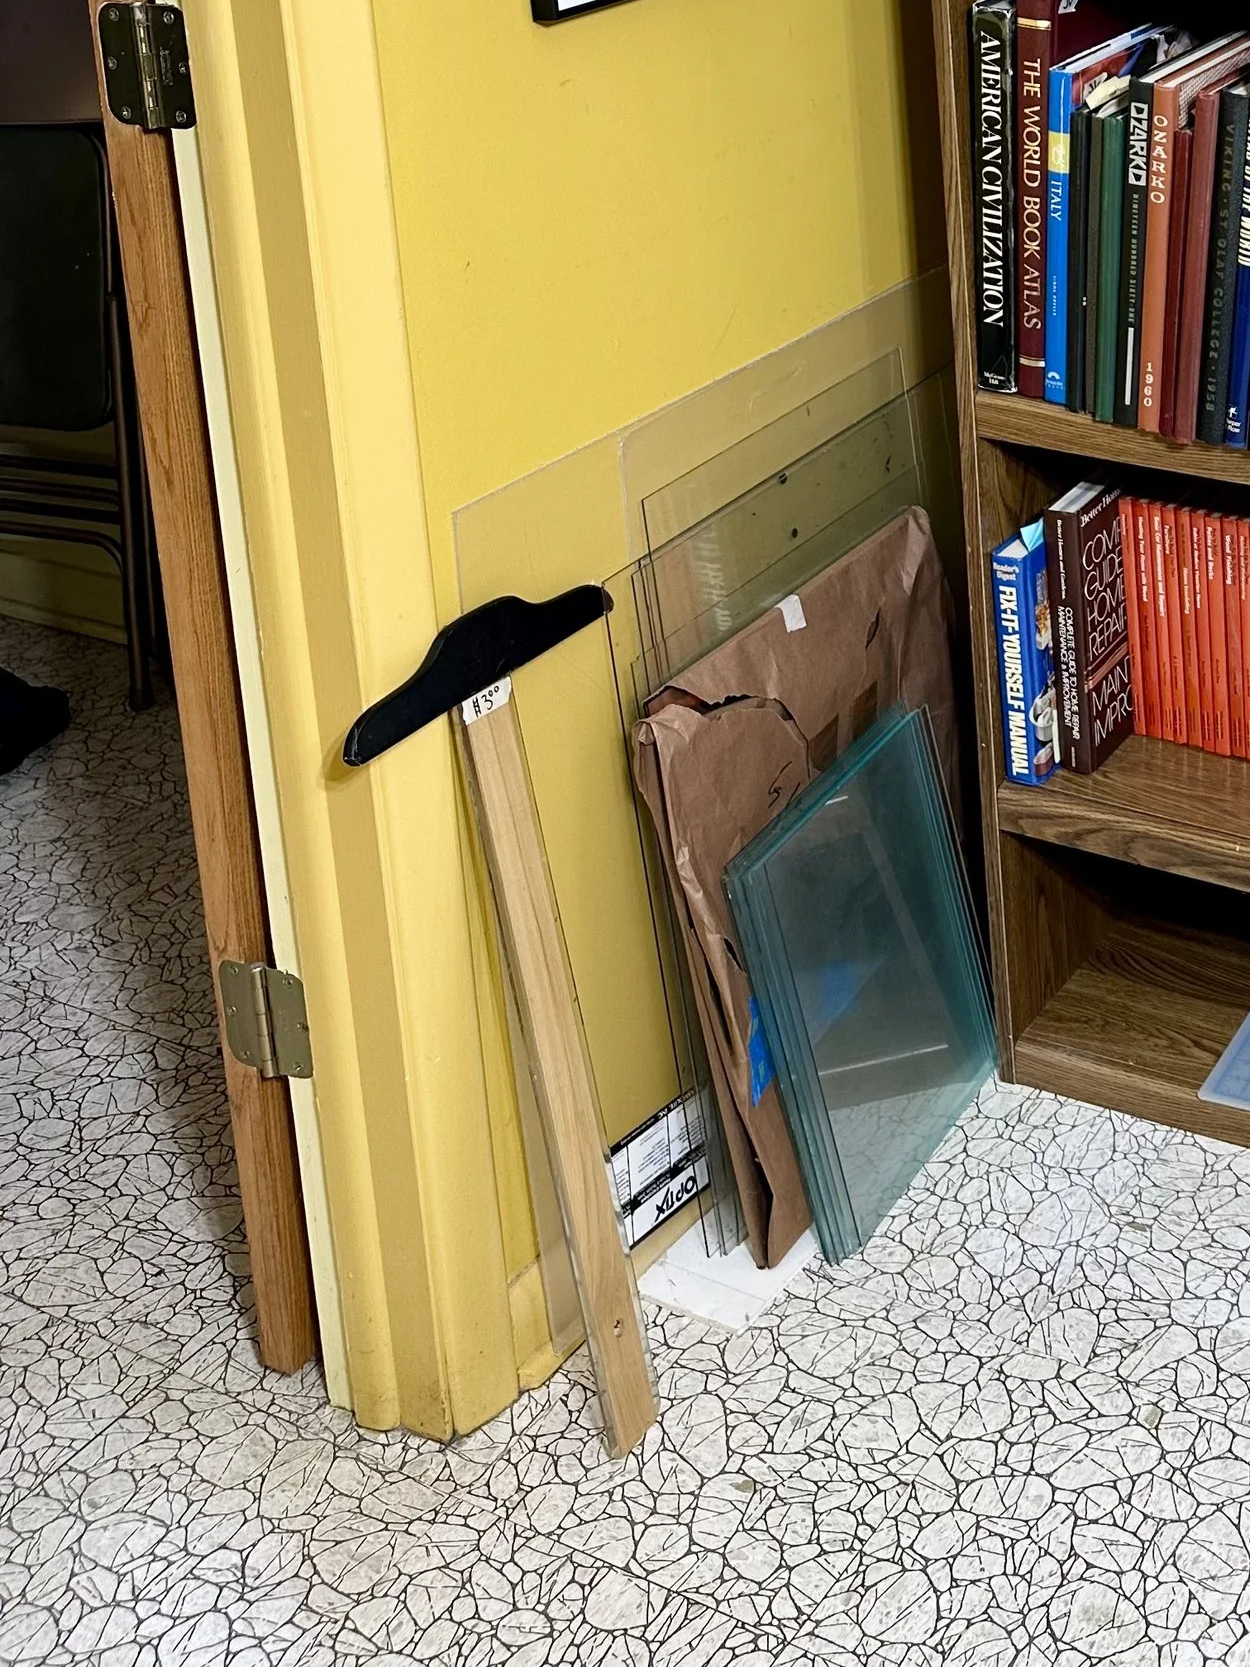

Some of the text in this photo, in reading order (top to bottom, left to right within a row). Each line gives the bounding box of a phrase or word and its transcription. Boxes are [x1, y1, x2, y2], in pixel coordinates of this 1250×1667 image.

[1128, 102, 1148, 186] OZARKO
[1149, 115, 1169, 204] OZARKO
[1221, 124, 1235, 193] VIKING
[980, 31, 1004, 328] AMERICAN CIVILIZATION
[1022, 59, 1042, 329] THE WORLD BOOK ATLAS
[1049, 180, 1062, 221] ITALY
[1215, 239, 1227, 278] OLAF
[1209, 289, 1224, 359] COLLEGE
[1143, 362, 1154, 407] 1960
[1205, 377, 1217, 412] 1958
[1225, 556, 1233, 584] Finishing
[1057, 606, 1068, 662] MAINTENANCE
[1061, 671, 1072, 727] IMPROVEMENT
[1065, 607, 1080, 739] COMPLETE GUIDE TO HOME REPAIR
[1008, 710, 1028, 776] MANUAL
[655, 1175, 697, 1223] OPTIX
